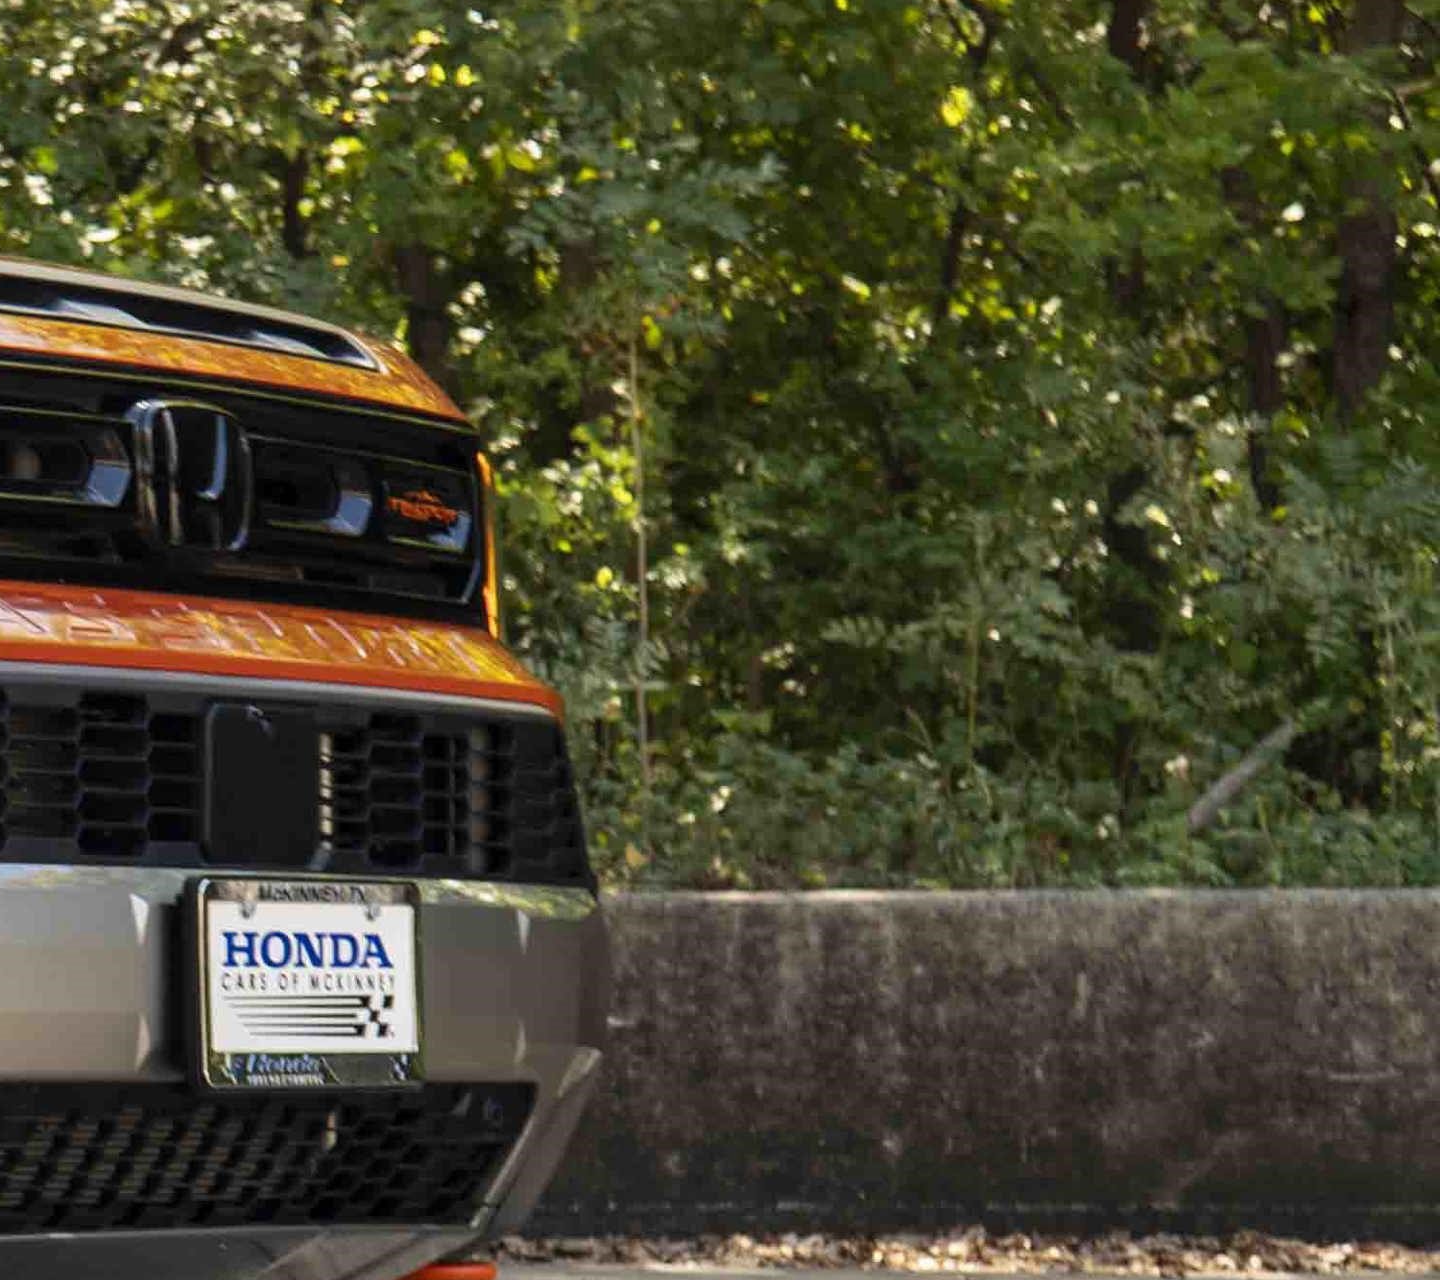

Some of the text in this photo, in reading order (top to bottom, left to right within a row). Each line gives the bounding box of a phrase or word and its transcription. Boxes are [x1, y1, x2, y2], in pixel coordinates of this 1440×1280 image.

[222, 930, 394, 969] HONDA
[221, 972, 267, 991] CARS
[280, 972, 298, 991] OF
